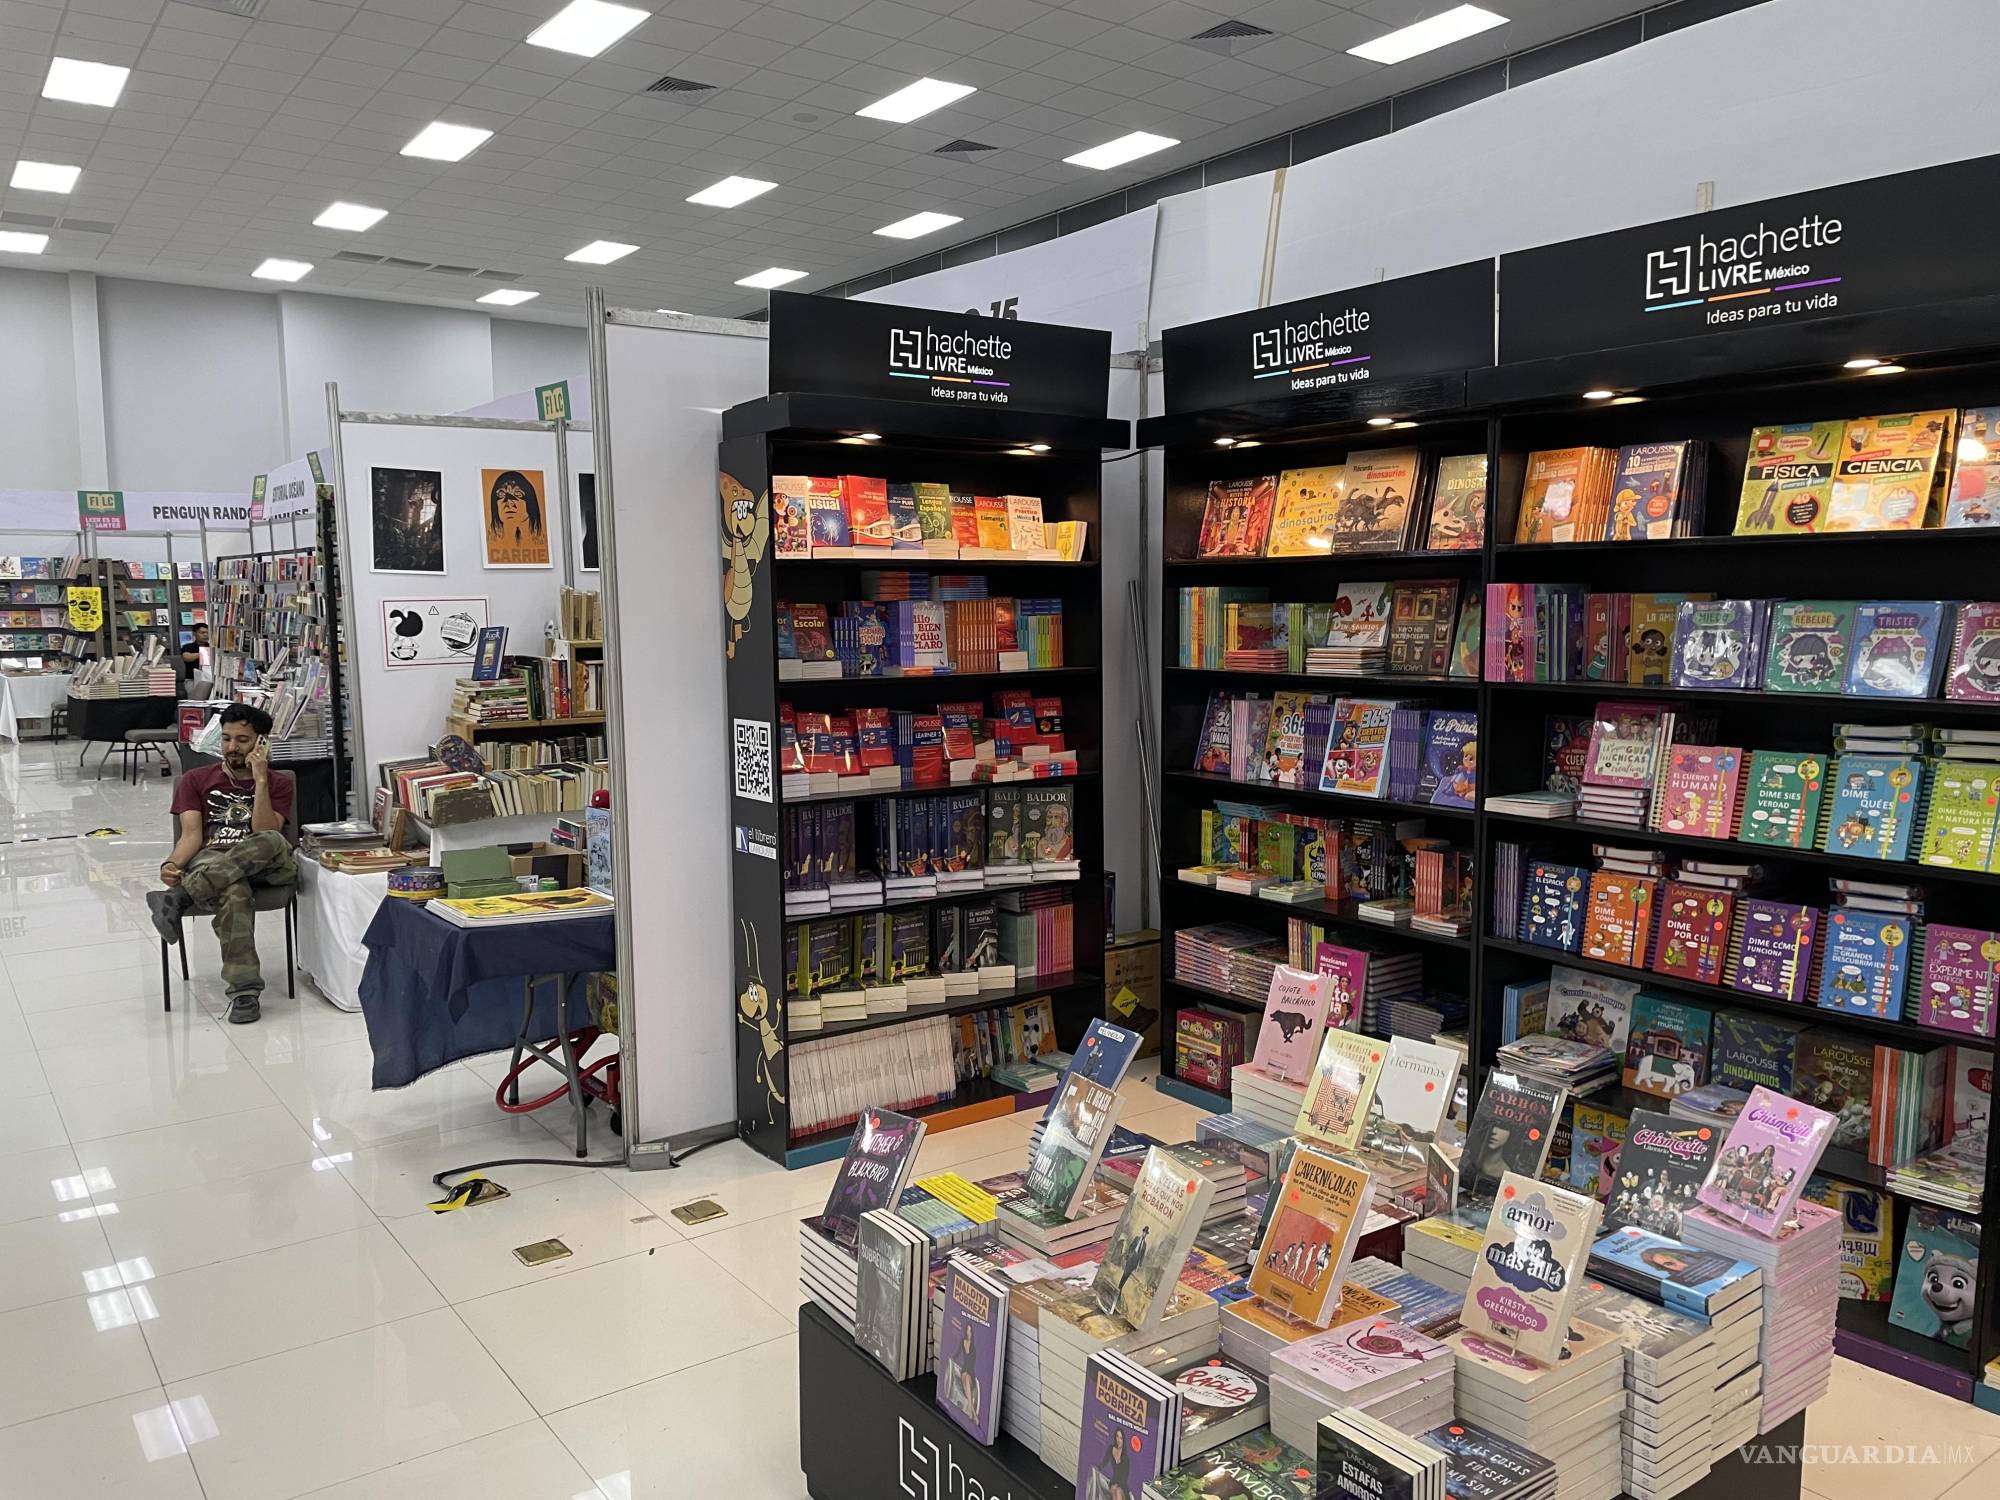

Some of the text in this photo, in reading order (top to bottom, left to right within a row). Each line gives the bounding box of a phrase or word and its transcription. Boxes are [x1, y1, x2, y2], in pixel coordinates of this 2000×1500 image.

[1700, 215, 1842, 266] hachette
[1699, 261, 1810, 292] LIVRE México
[1706, 292, 1838, 326] Ideas para tu vida
[1284, 308, 1370, 344] hachette
[927, 326, 1012, 360] hachette
[1285, 342, 1351, 364] LIVRE México
[926, 355, 994, 376] LIVRE México
[1291, 368, 1370, 391] Ideas para tu vida
[931, 387, 1008, 403] Ideas para tu vida
[1631, 446, 1675, 456] LAROUSSE
[1535, 462, 1546, 473] 10
[1629, 456, 1641, 467] 10
[1847, 459, 1923, 474] CIENCIA
[1367, 469, 1406, 480] dinosaurios
[1761, 462, 1820, 479] FÍSICA
[810, 500, 840, 511] usual
[1220, 497, 1256, 508] HISTORIA
[153, 506, 210, 520] PENGUIN
[213, 507, 251, 521] RANDO
[1280, 513, 1337, 528] dinosaurios
[491, 549, 547, 563] CARRIE
[794, 620, 825, 629] Escolar
[1647, 613, 1657, 622] LA
[1697, 612, 1729, 623] MIEDO
[1795, 615, 1832, 626] REBELDE
[1878, 616, 1915, 626] TRISTE
[918, 623, 941, 632] BIEN
[913, 719, 941, 728] AROUSSE
[1361, 708, 1391, 728] 365
[1434, 719, 1445, 731] El
[1612, 754, 1646, 764] CHICAS
[1027, 793, 1067, 802] BALDOR
[1760, 790, 1782, 800] DIME
[1842, 789, 1869, 799] DIME
[826, 805, 852, 819] BALDOR
[952, 798, 980, 811] BALDOR
[1758, 800, 1790, 809] VERDAD
[756, 829, 777, 846] librero
[975, 909, 994, 917] MUNDO
[976, 915, 990, 923] SOFÍA
[1594, 907, 1615, 917] DIME
[1667, 920, 1691, 931] DIME
[1674, 930, 1692, 939] POR
[1749, 937, 1770, 947] DIME
[1935, 929, 1977, 942] LAROUSSE
[1747, 946, 1782, 957] FUNCIONA
[1840, 951, 1873, 960] GRANDES
[1832, 955, 1899, 971] DESCUBRIMIENOS
[1279, 985, 1301, 994] COYOTE
[1281, 996, 1316, 1006] BALCÁNICO
[1657, 1021, 1683, 1031] mundo
[1726, 1049, 1778, 1072] LAROUSSE
[1813, 1046, 1872, 1068] LAROUSSE
[1391, 1056, 1446, 1078] Hermanas
[1723, 1062, 1780, 1088] DINOSAURIOS
[1824, 1061, 1859, 1077] Cuentos
[1489, 1090, 1548, 1115] CARBÓN
[1634, 1129, 1707, 1160] Chismecito
[848, 1160, 889, 1182] BLACKBIRD
[1294, 1160, 1358, 1198] CAVERNÍCOLAS
[1142, 1190, 1174, 1220] ROBARON
[1171, 1198, 1184, 1211] NOS
[1507, 1206, 1554, 1232] amor
[1527, 1257, 1562, 1287] allá
[955, 1278, 988, 1307] MALDITA
[954, 1287, 988, 1320] POBREZA
[1499, 1296, 1527, 1312] KIRSTY
[1484, 1299, 1538, 1328] GREENWOOD
[1312, 1350, 1358, 1374] SIN REGLAS
[1182, 1370, 1253, 1399] RADLEY
[1100, 1375, 1144, 1413] MALDITA
[1098, 1387, 1143, 1425] POBREZA
[1108, 1413, 1116, 1421] SAL
[1122, 1419, 1133, 1428] ESTE
[1133, 1425, 1149, 1435] HOGAR
[1346, 1451, 1379, 1474] LAROUSSE
[1467, 1442, 1490, 1457] LAS
[1490, 1453, 1531, 1476] COSAS
[1342, 1461, 1383, 1494] ESTAFAS
[1465, 1460, 1512, 1486] FUESEN
[1466, 1479, 1494, 1496] SON
